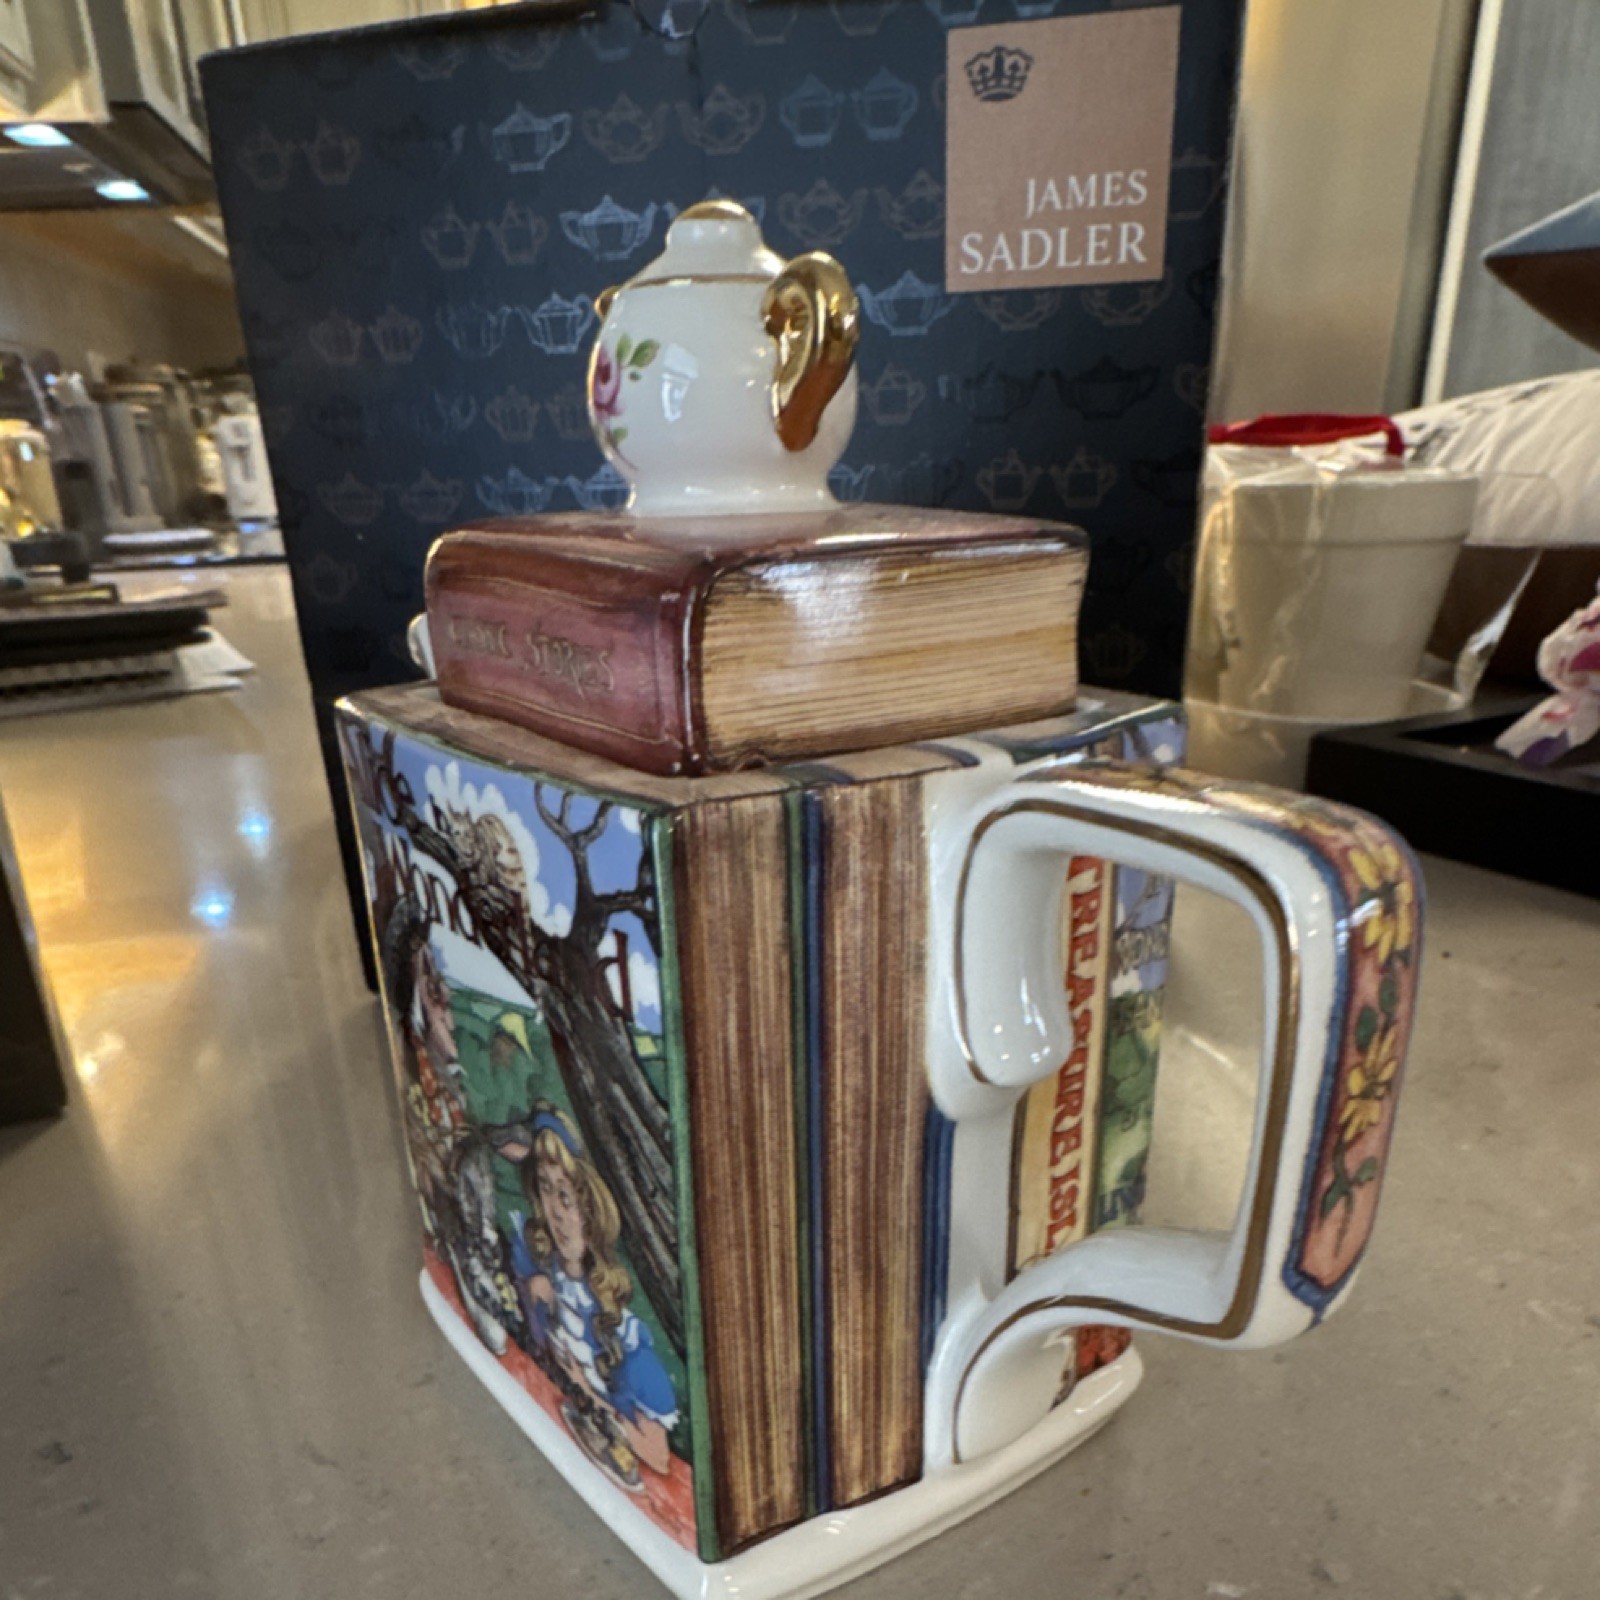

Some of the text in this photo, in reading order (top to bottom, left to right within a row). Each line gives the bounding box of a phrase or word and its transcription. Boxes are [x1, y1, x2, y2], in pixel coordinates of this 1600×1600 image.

[1026, 169, 1148, 218] JAMES
[960, 222, 1147, 274] SADLER
[1045, 855, 1104, 1257] TREASURE ISL
